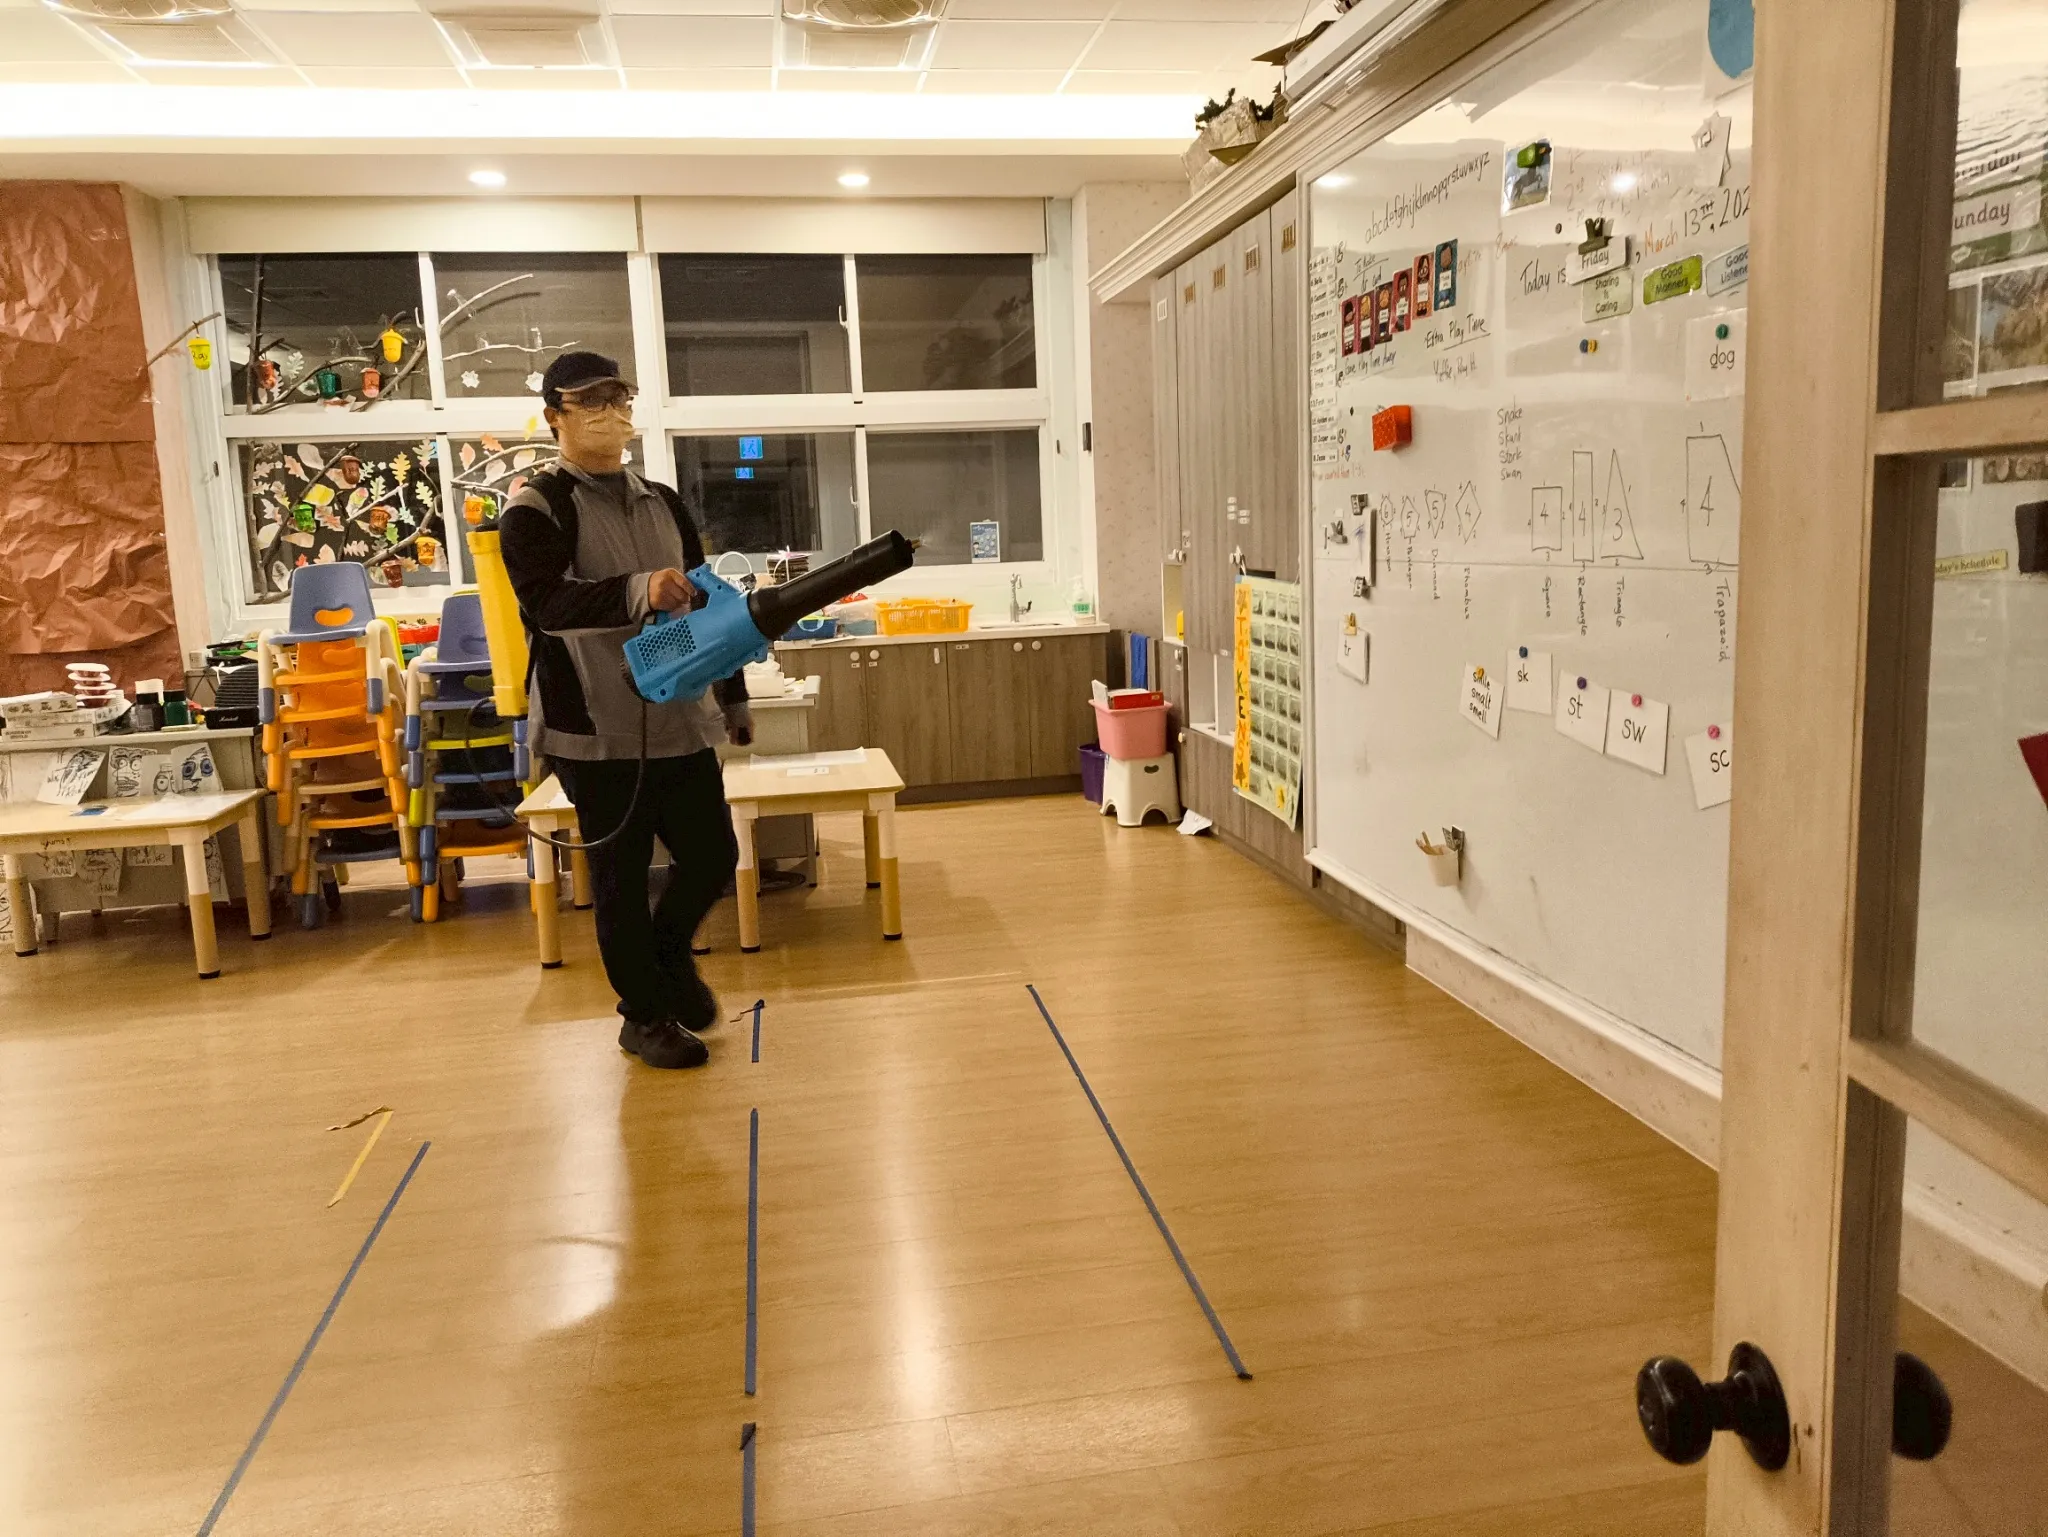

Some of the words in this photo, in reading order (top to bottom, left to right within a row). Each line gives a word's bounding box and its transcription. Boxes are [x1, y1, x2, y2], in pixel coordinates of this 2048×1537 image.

[1365, 151, 1490, 244] abcdefghijklmnopqrstuvwxyz
[1645, 222, 1678, 257] March
[1582, 250, 1609, 268] Friday
[1661, 265, 1683, 279] Good
[1520, 258, 1550, 296] Today
[1557, 265, 1567, 284] is
[1655, 276, 1689, 294] Manners
[1596, 301, 1618, 314] Caring
[1449, 320, 1464, 344] Play
[1467, 313, 1486, 334] Time
[1710, 344, 1735, 370] dog
[1497, 402, 1522, 425] Snake
[1499, 447, 1522, 464] Stork
[1501, 468, 1521, 480] Swan
[1432, 500, 1439, 520] 5
[1464, 503, 1472, 522] 4
[1540, 502, 1549, 526] 4
[1700, 475, 1714, 527] 4
[1579, 500, 1586, 537] 4
[1613, 507, 1623, 541] 3
[1431, 548, 1441, 600] Diamond
[1703, 563, 1713, 576] 3
[1542, 576, 1552, 618] Square
[1577, 576, 1588, 637] Rectangle
[1613, 576, 1626, 628] Triangle
[1235, 616, 1249, 761] TOKENS
[1469, 702, 1487, 724] smell
